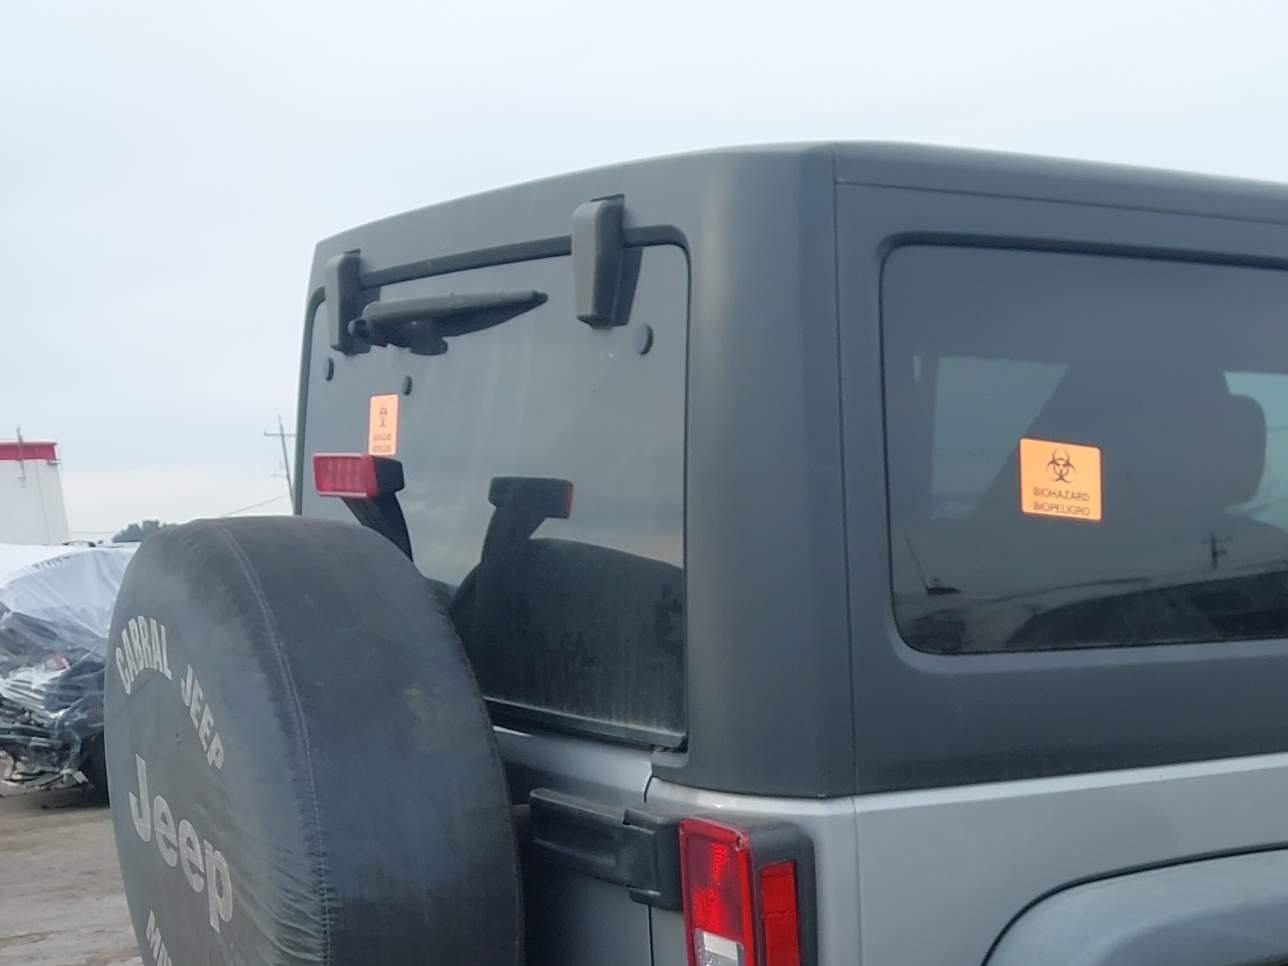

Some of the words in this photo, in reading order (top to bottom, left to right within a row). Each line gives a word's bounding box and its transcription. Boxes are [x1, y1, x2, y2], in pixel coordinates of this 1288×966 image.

[1033, 486, 1090, 502] BIOHAZARD
[1033, 501, 1090, 517] BIOPELIGRO
[115, 615, 173, 695] CABRAL
[180, 663, 225, 769] JEEP
[128, 753, 234, 933] Jeep
